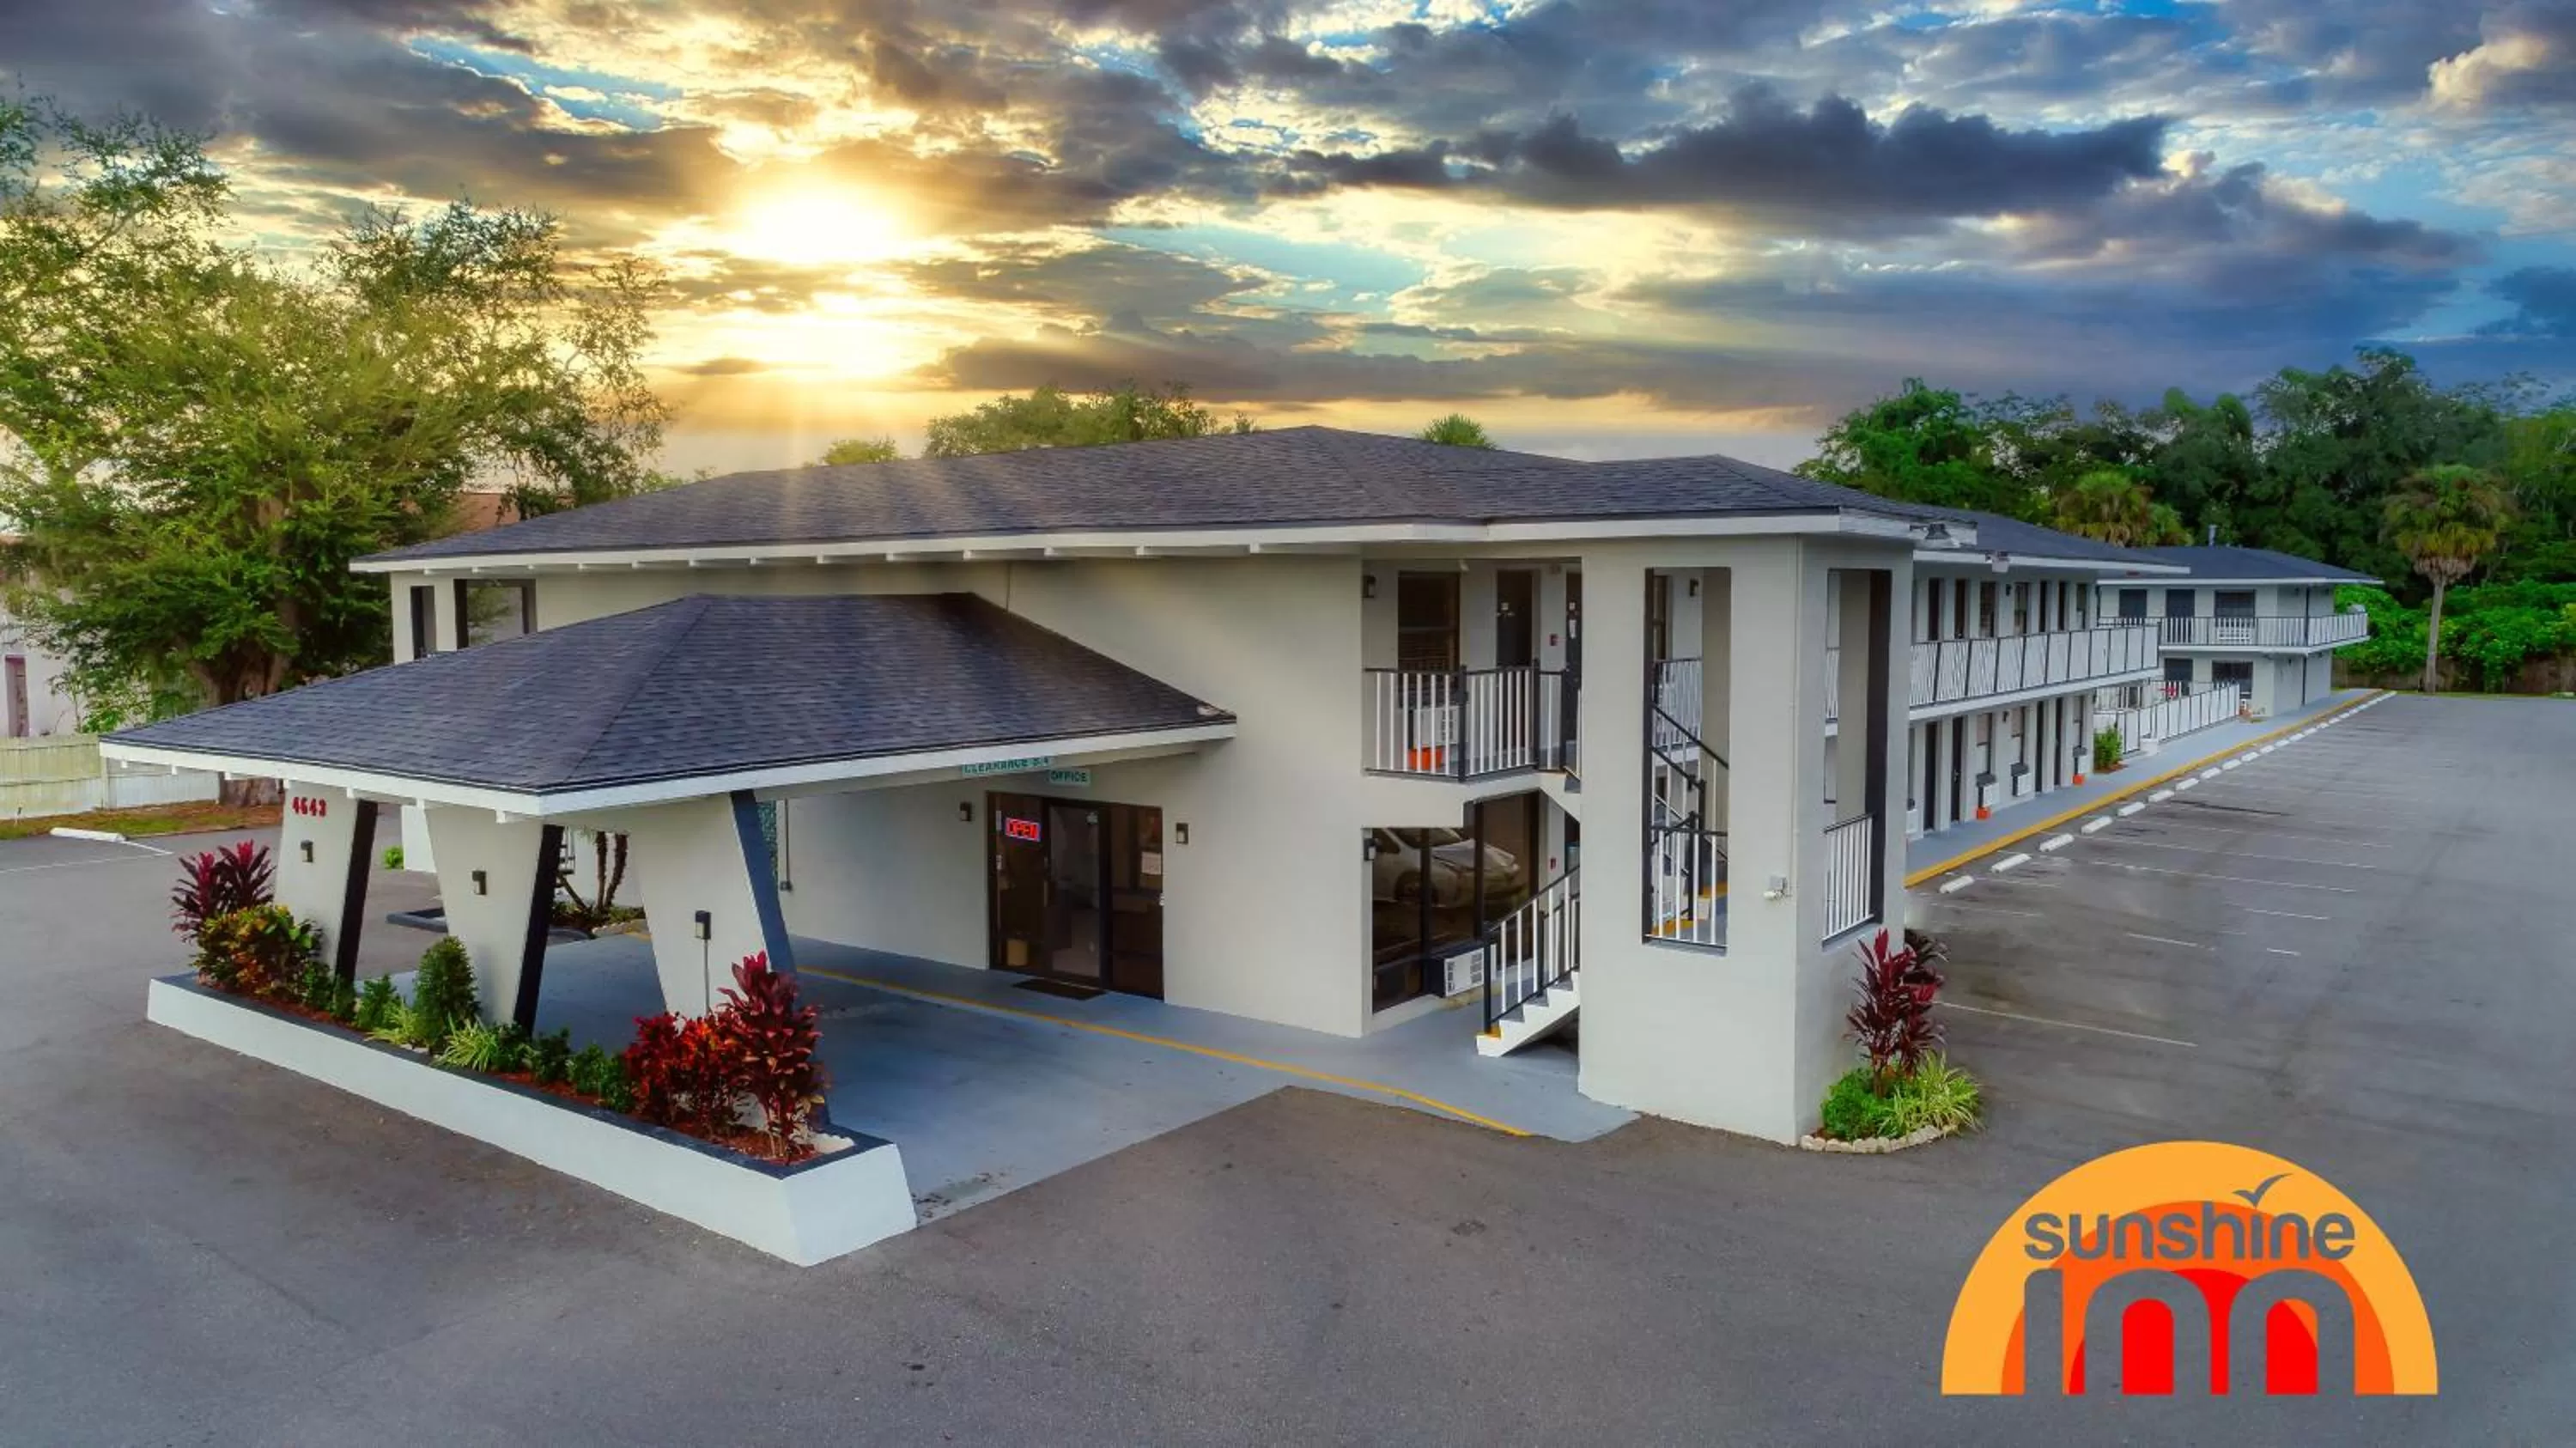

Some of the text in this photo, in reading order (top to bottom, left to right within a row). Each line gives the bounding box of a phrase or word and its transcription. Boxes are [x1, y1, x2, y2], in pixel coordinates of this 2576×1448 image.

[1050, 770, 1087, 782] OFFICE
[293, 796, 326, 817] 4643
[1008, 819, 1039, 839] OPEN
